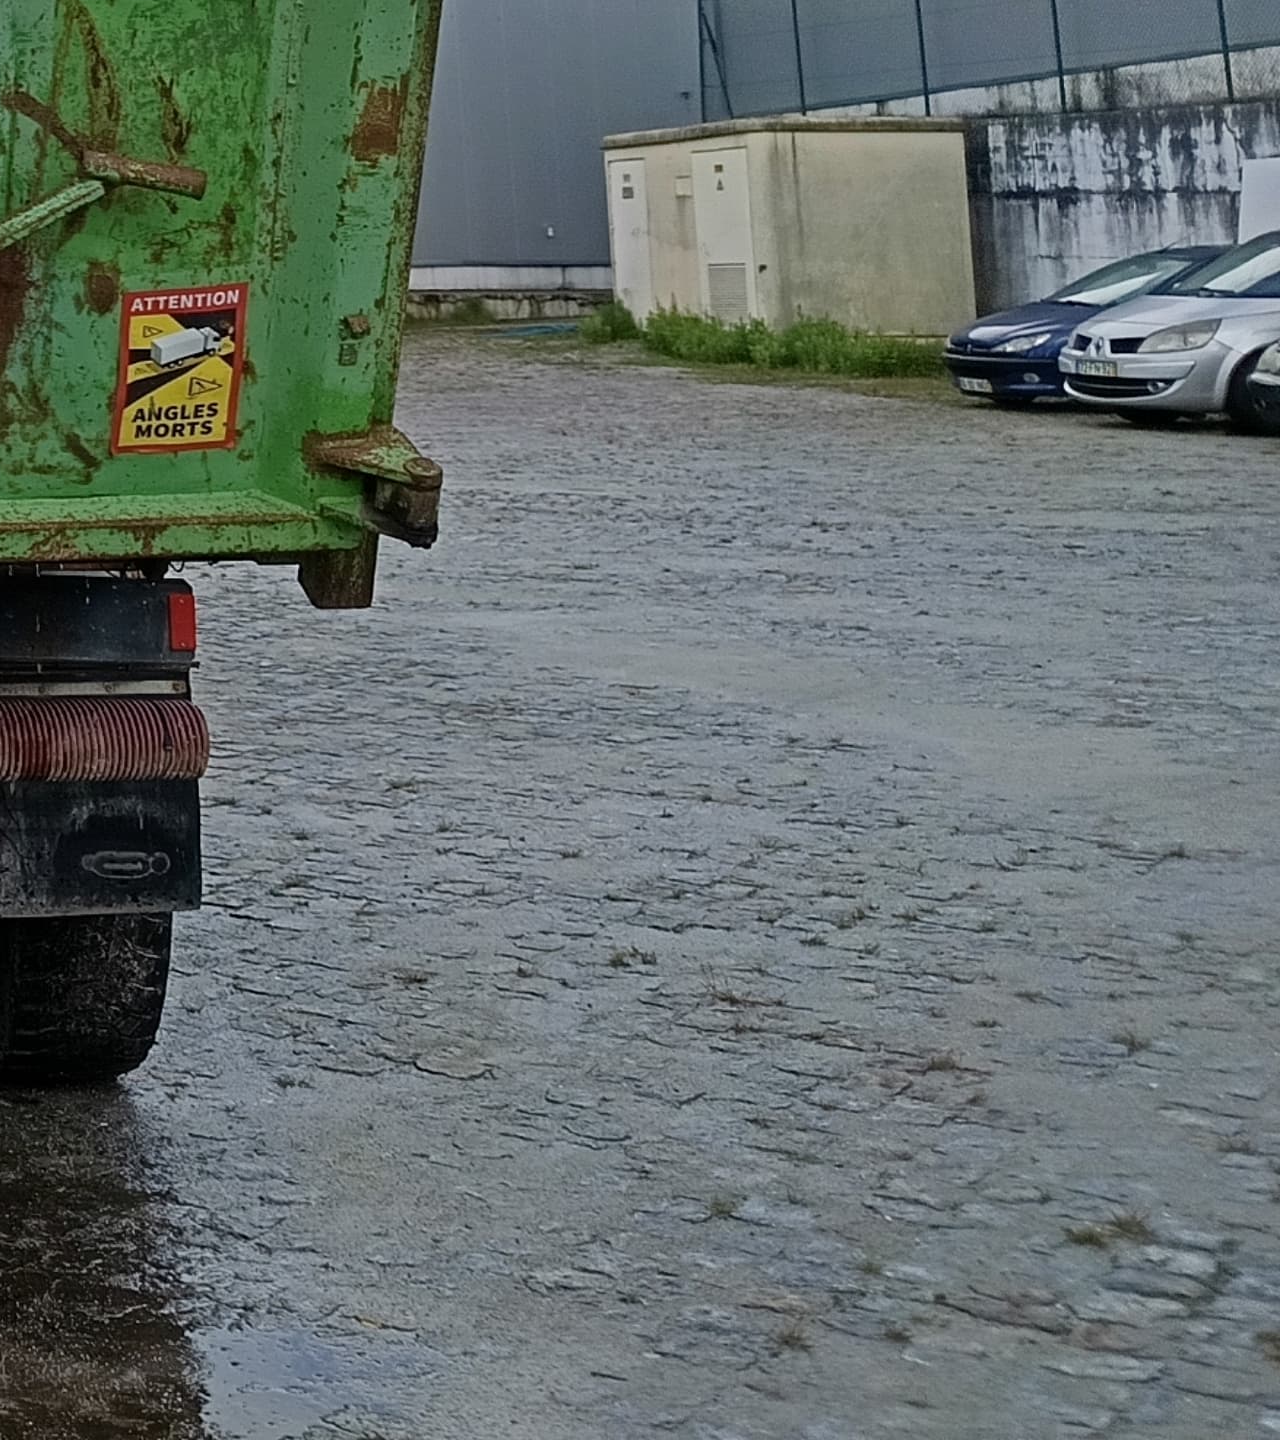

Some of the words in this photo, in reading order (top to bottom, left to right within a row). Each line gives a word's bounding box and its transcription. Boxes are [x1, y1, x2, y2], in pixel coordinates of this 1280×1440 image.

[131, 289, 239, 311] ATTENTION
[132, 402, 219, 422] ANGLES
[135, 421, 212, 439] MORTS
